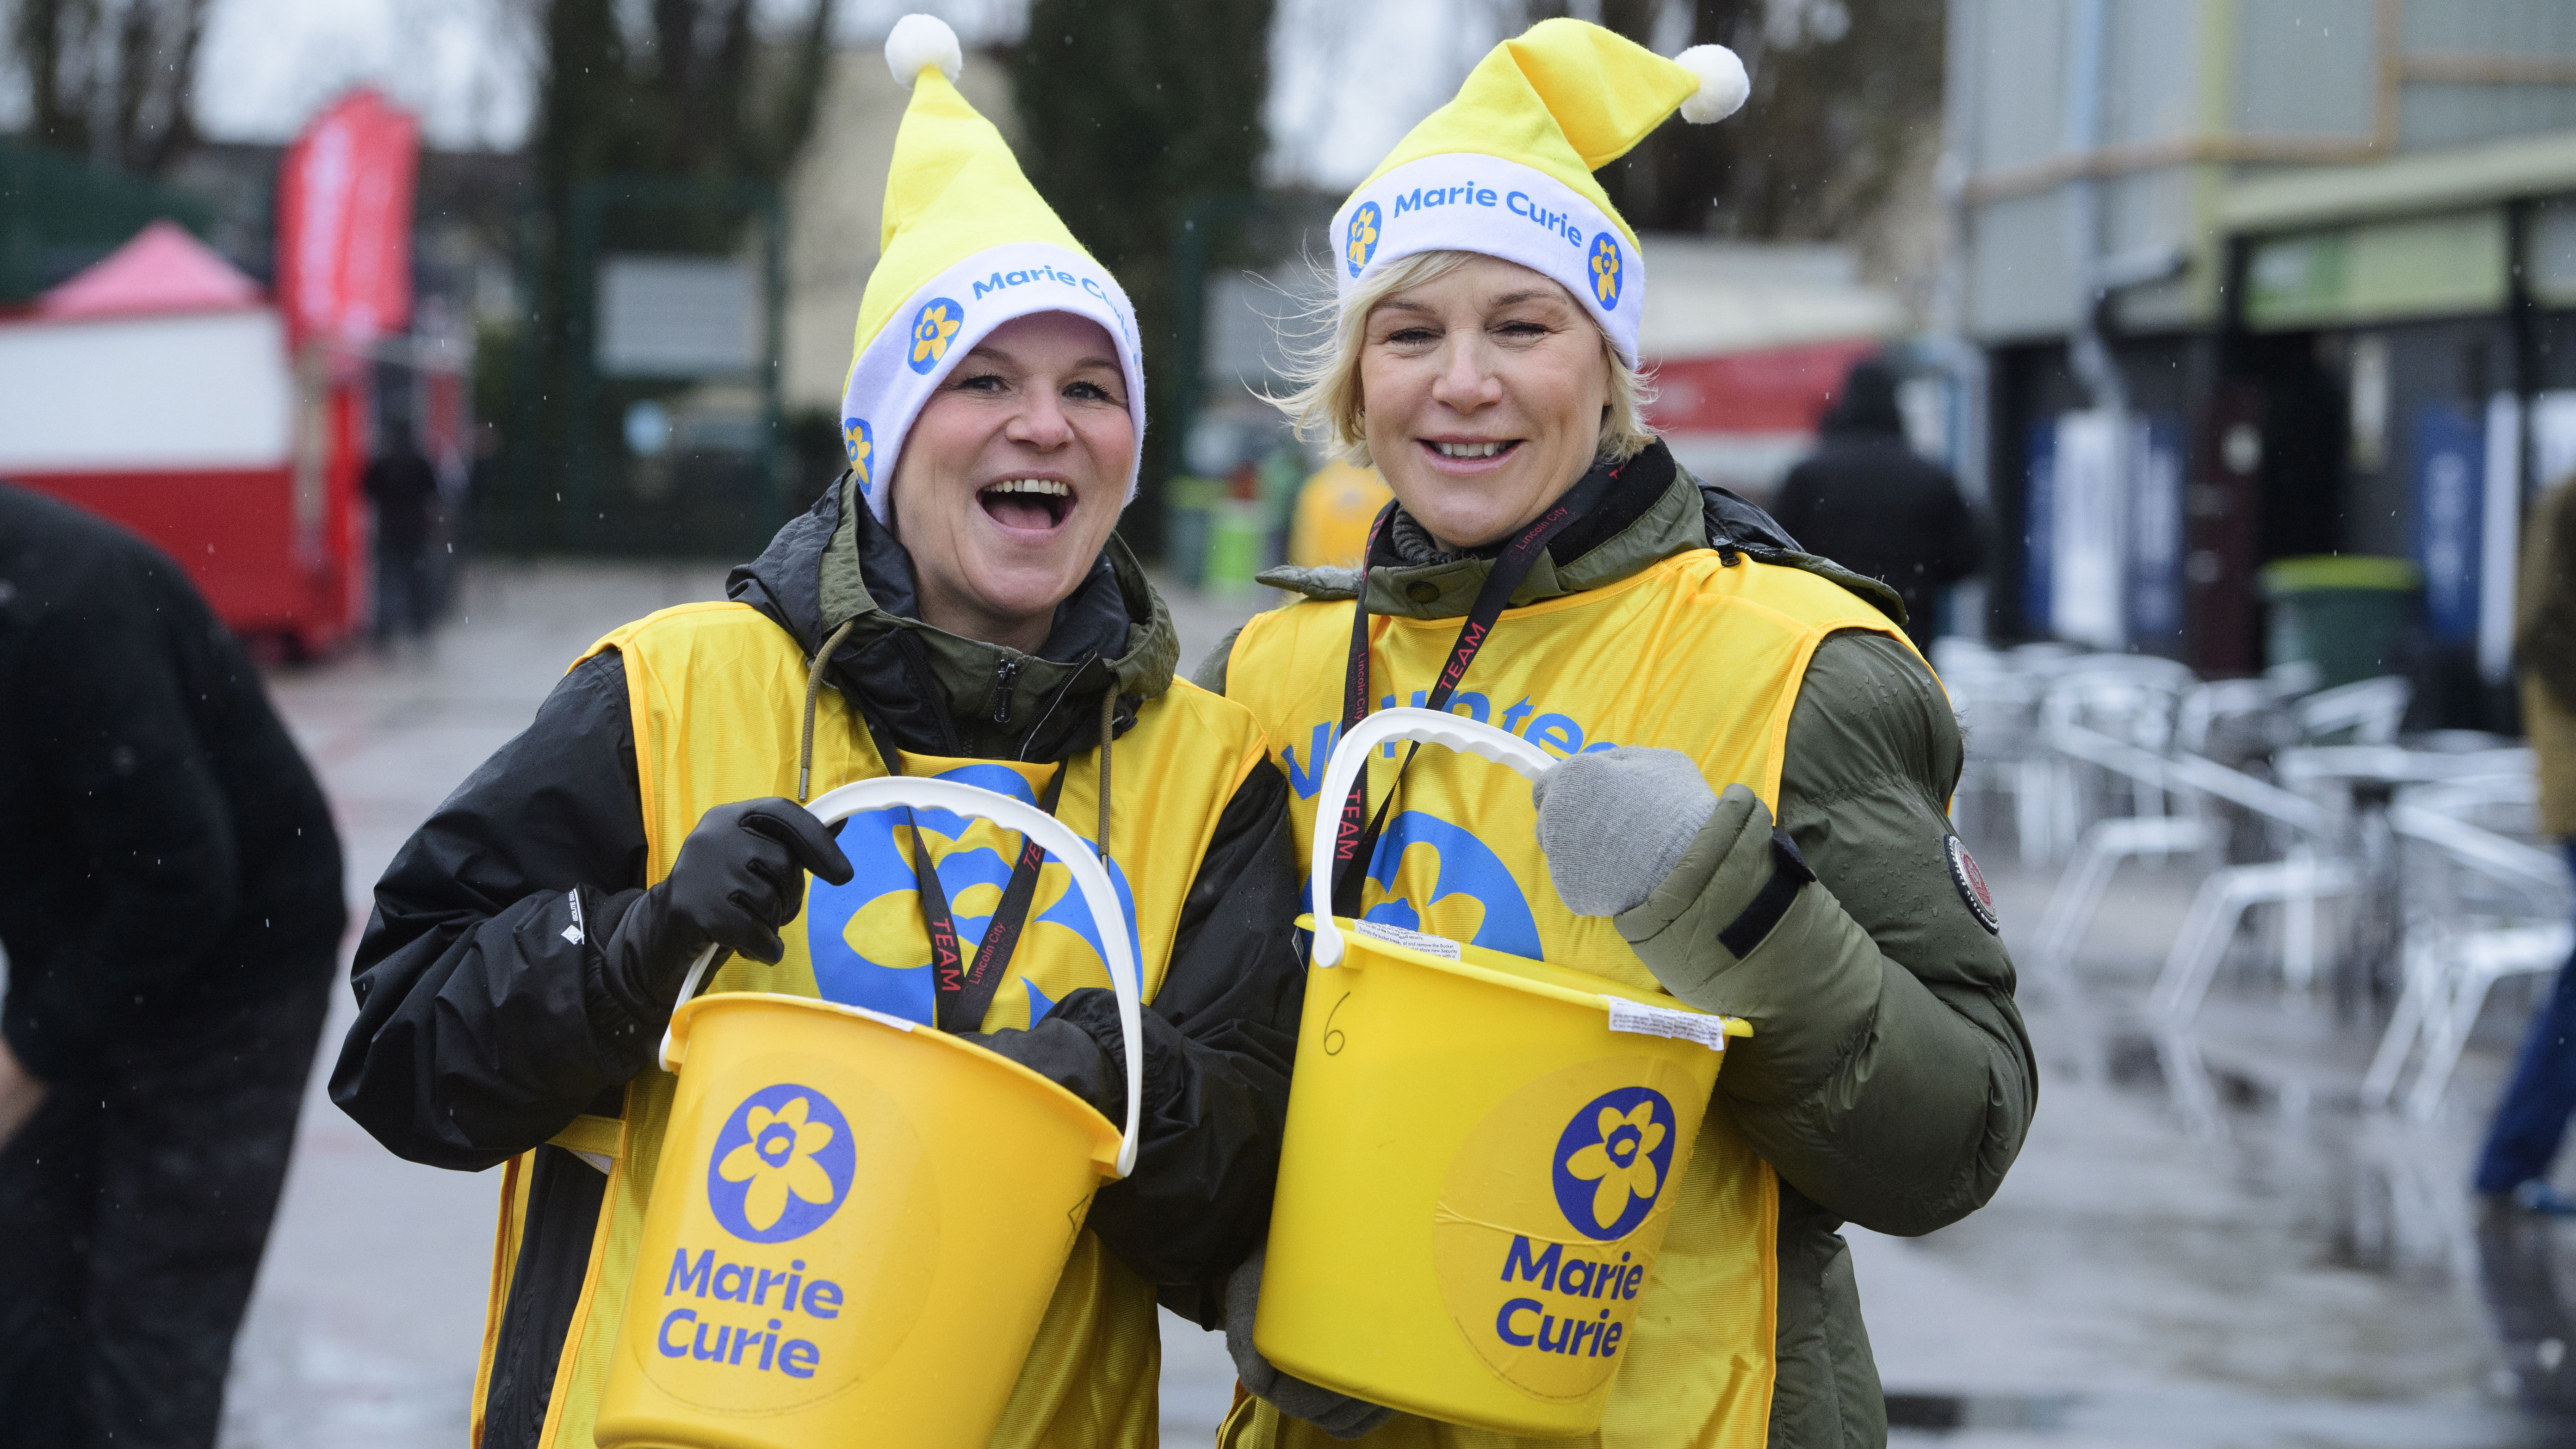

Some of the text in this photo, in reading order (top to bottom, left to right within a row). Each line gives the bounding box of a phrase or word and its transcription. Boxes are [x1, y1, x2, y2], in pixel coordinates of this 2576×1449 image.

[1393, 181, 1582, 248] Marie Curie
[972, 265, 1130, 346] Marie Curie
[1516, 506, 1567, 550] Lincoln City
[1355, 653, 1366, 720] Lincoln City
[1438, 622, 1486, 689] TEAM
[570, 901, 578, 921] ISOLITE
[933, 918, 961, 991] TEAM
[969, 922, 1006, 985] Lincoln City
[1324, 991, 1350, 1055] 6
[664, 1248, 844, 1319] Marie
[1500, 1234, 1644, 1300] Marie
[657, 1308, 820, 1379] Curie
[1496, 1297, 1622, 1357] Curie
